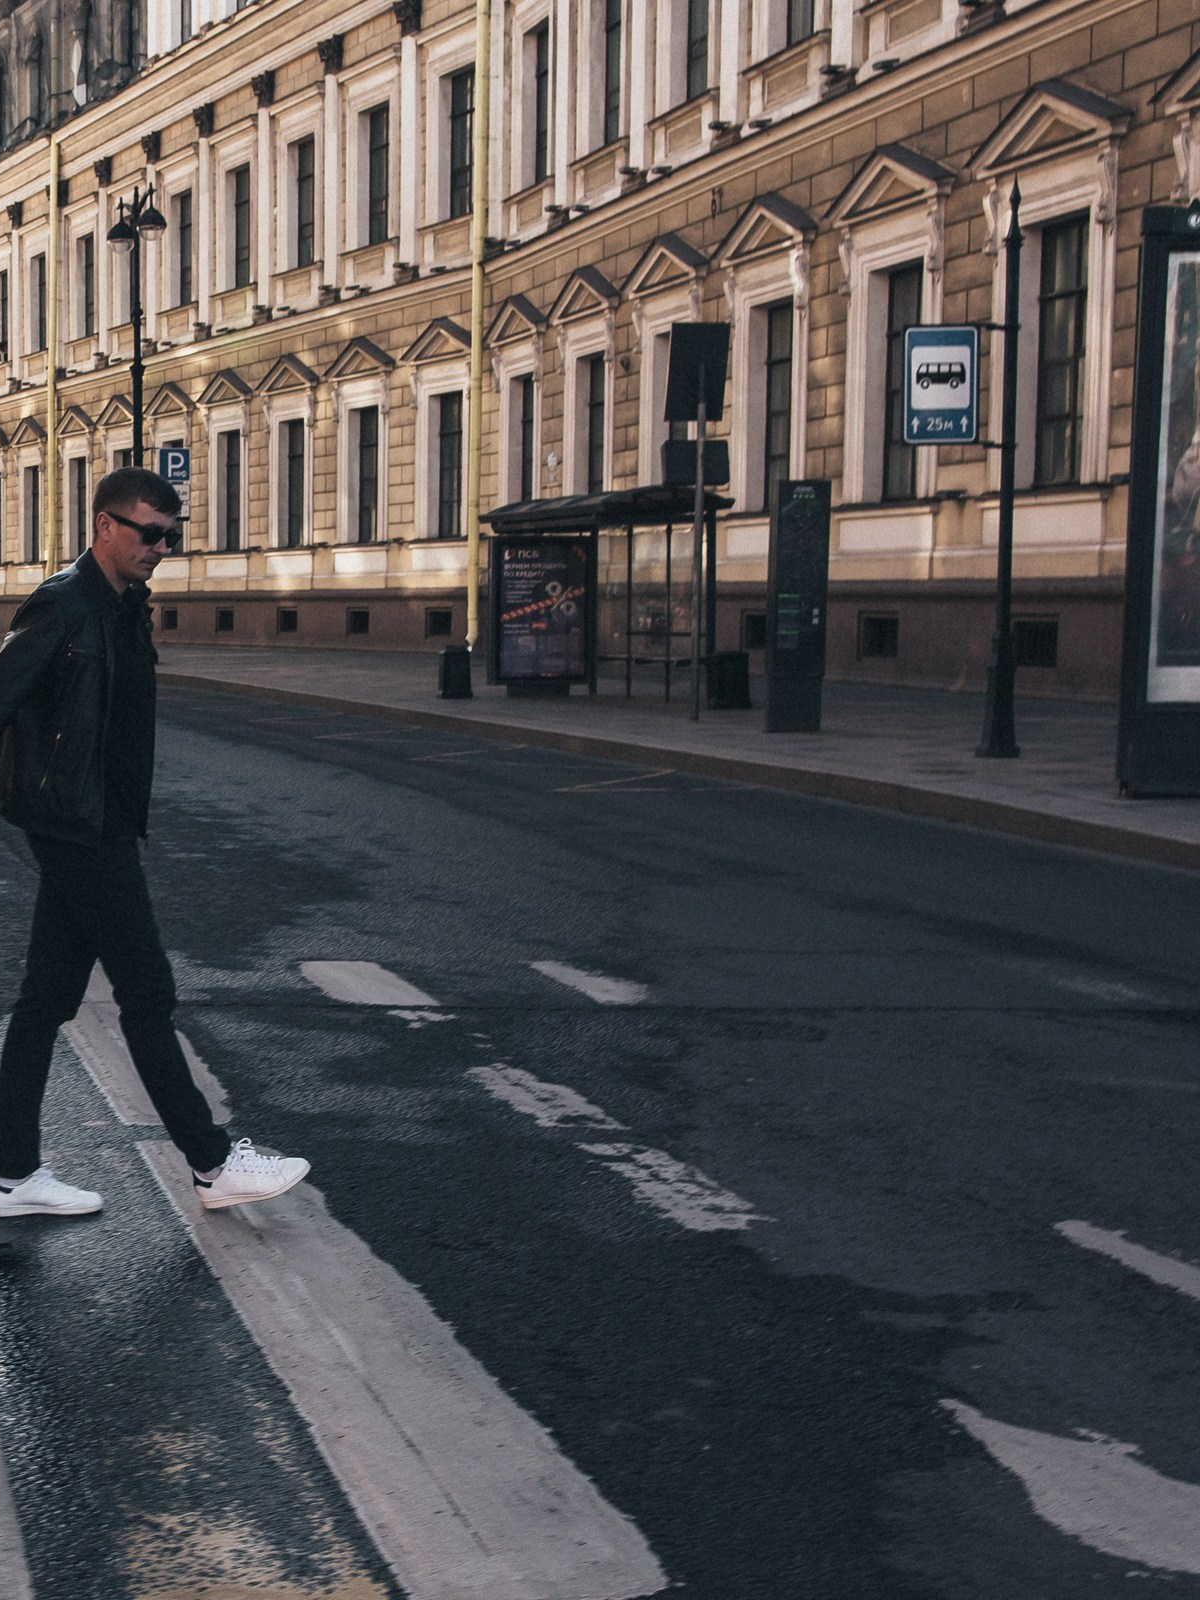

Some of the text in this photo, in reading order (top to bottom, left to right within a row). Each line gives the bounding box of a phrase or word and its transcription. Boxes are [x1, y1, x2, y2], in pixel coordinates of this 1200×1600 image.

[926, 416, 954, 432] 25м
[167, 452, 185, 478] P
[518, 549, 539, 559] ПСБ
